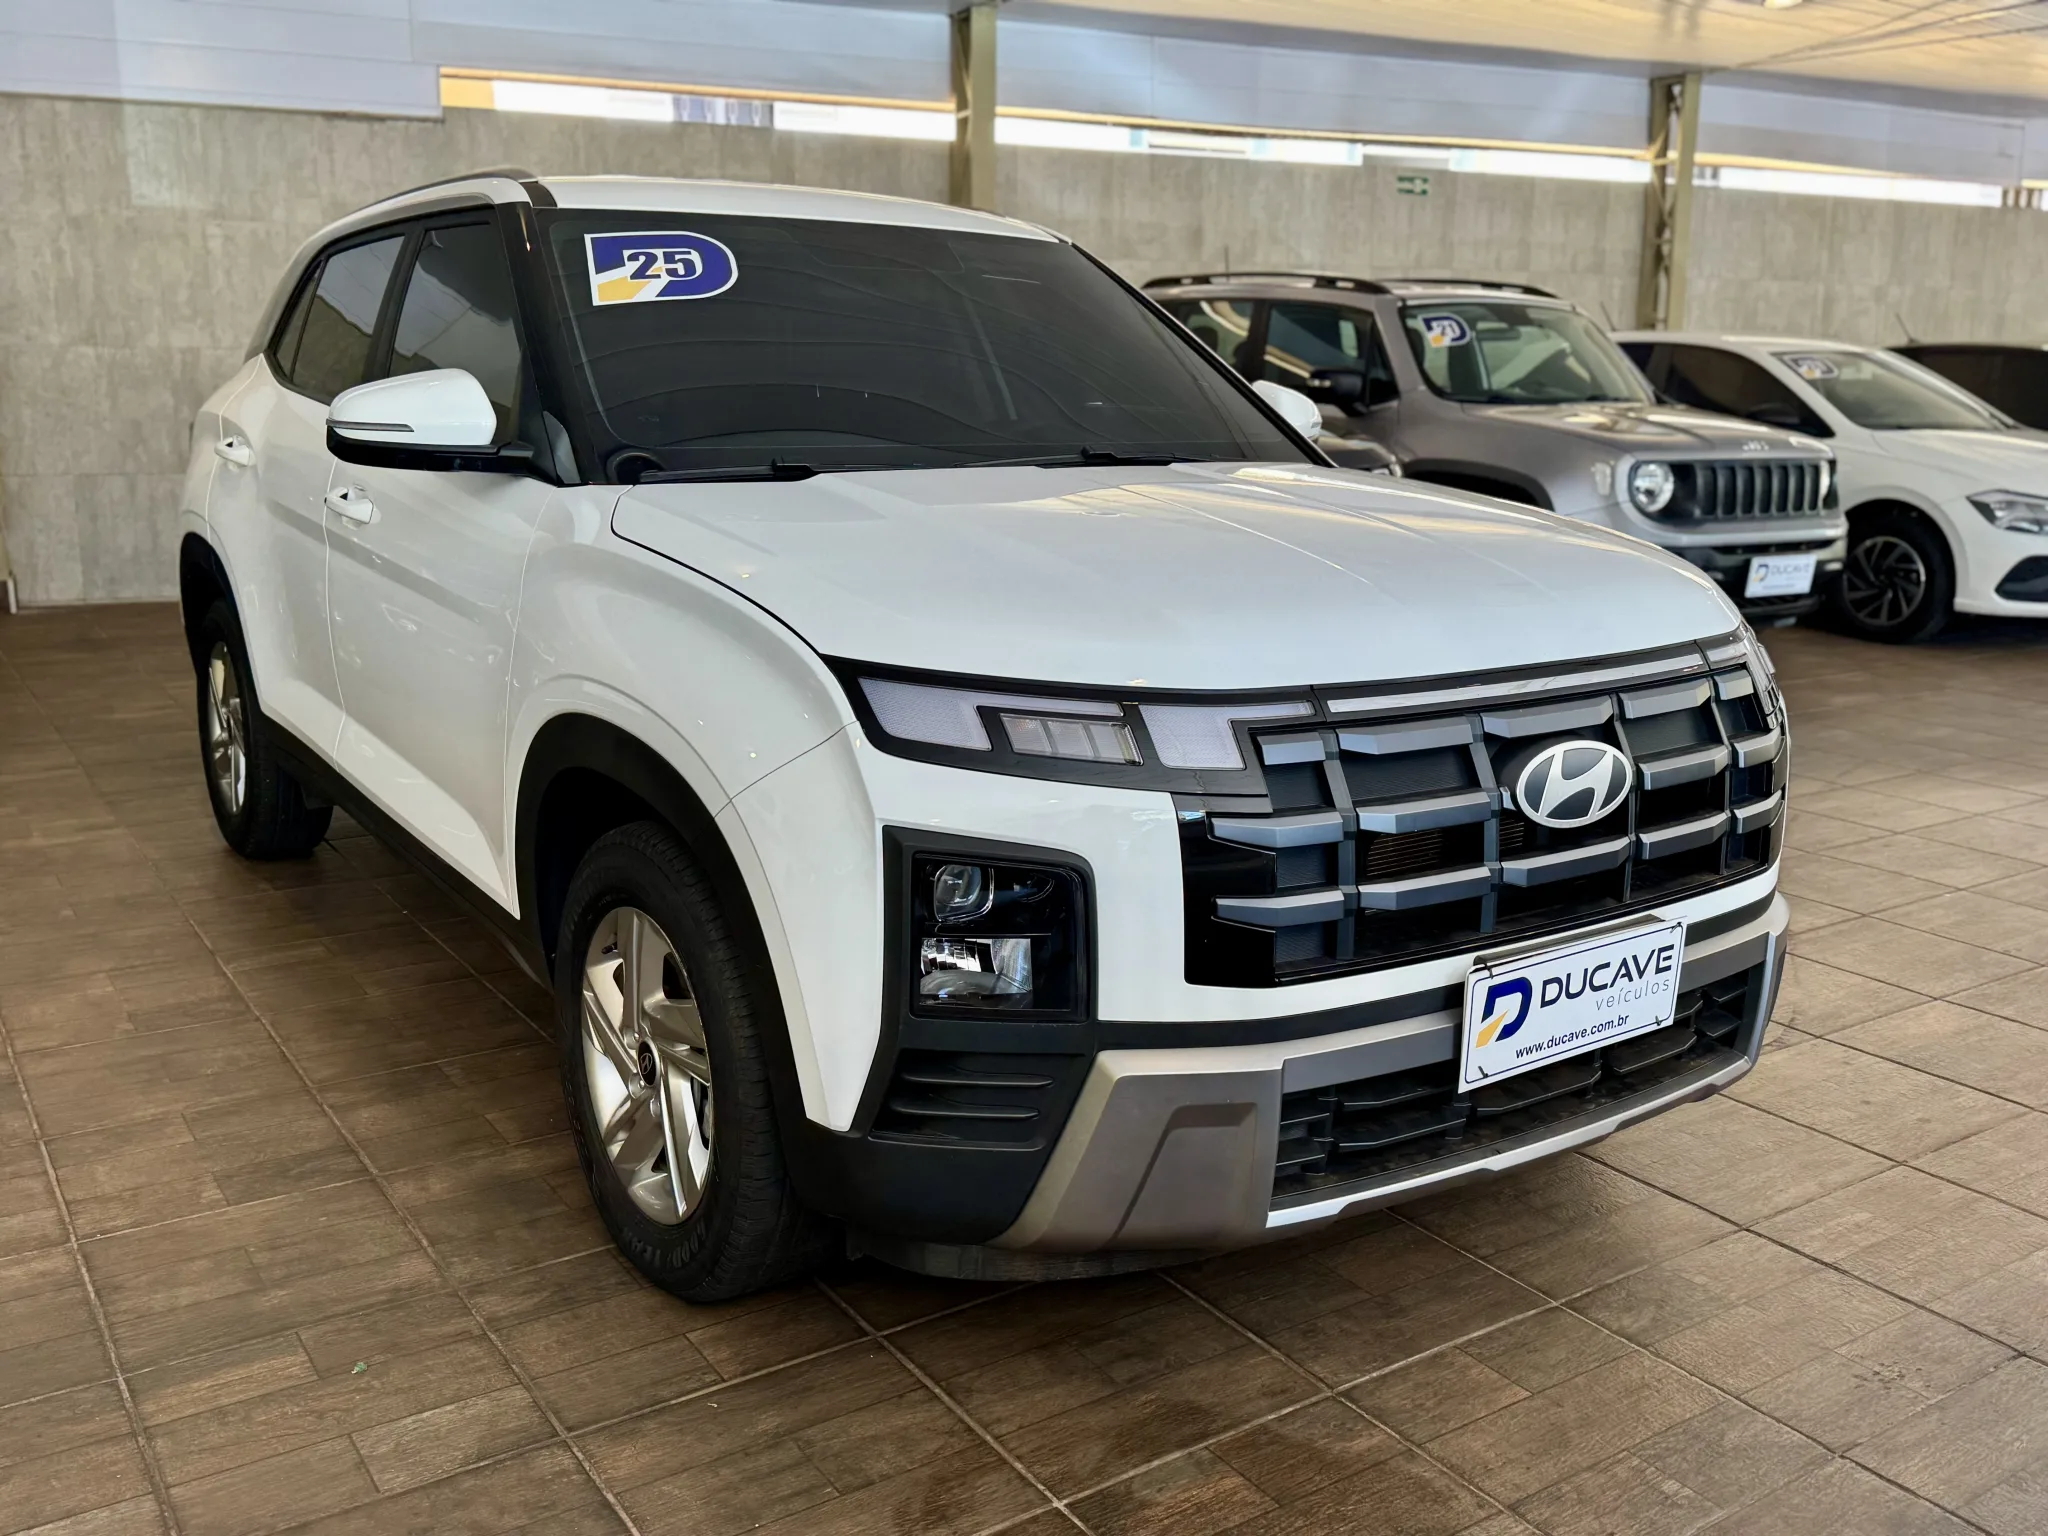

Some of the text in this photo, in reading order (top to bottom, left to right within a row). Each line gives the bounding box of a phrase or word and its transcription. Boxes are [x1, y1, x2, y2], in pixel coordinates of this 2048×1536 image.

[626, 250, 697, 280] 25
[1540, 943, 1675, 1008] DUCAVE
[1595, 978, 1670, 1011] veículos
[1515, 1013, 1629, 1059] www.ducave.com.br
